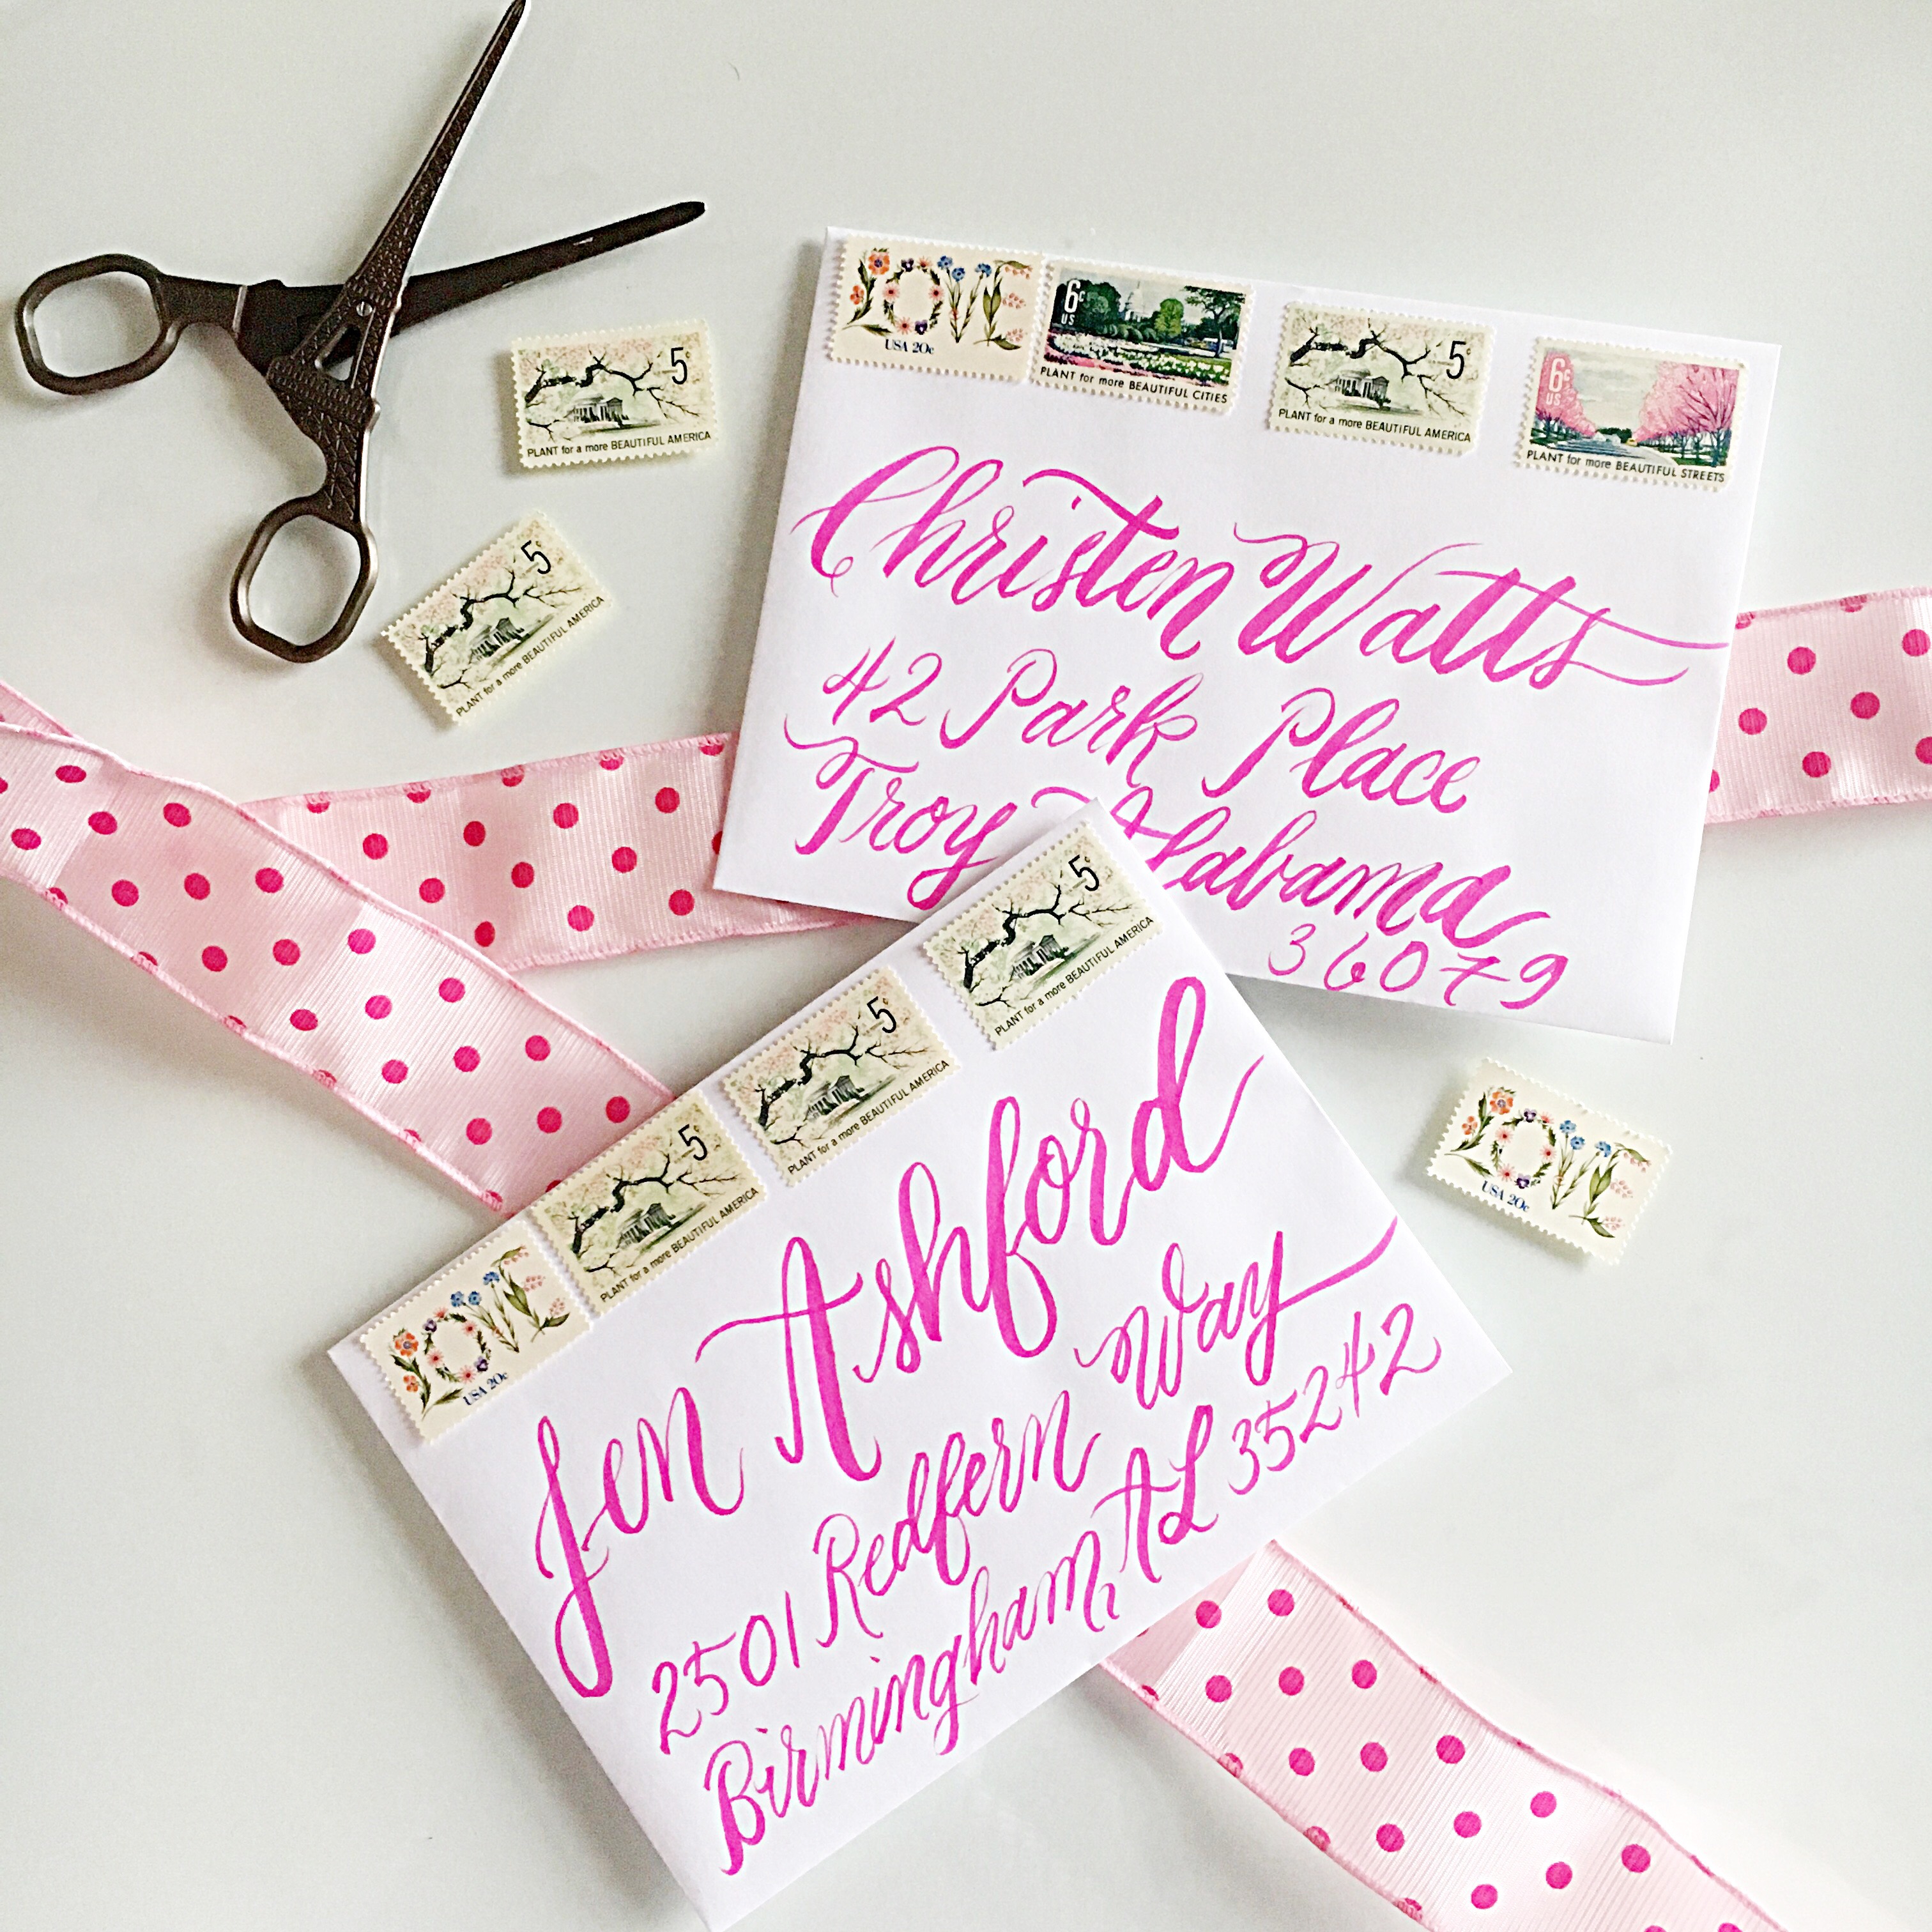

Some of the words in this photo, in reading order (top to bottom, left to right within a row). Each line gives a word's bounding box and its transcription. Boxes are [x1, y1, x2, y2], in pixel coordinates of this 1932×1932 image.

[885, 339, 908, 352] USA
[1061, 313, 1075, 325] US
[1040, 367, 1077, 381] PLANT
[1079, 372, 1094, 383] for
[1099, 377, 1124, 388] more
[1129, 380, 1188, 399] BEAUTIFUL
[1192, 390, 1228, 404] CITIES
[1278, 408, 1312, 422] PLANT
[1314, 413, 1327, 424] for
[1338, 417, 1363, 429] more
[1365, 420, 1422, 437] BEAUTIFUL
[1424, 427, 1471, 443] AMERICA
[1545, 392, 1561, 406] US
[527, 447, 557, 457] PLANT
[585, 443, 608, 452] more
[611, 436, 664, 450] BEAUTIFUL
[668, 431, 711, 444] AMERICA
[1526, 450, 1563, 463] PLANT
[1567, 454, 1581, 464] for
[1585, 458, 1611, 469] more
[1616, 461, 1676, 477] BEAUTIFUL
[1681, 468, 1725, 482] STREETS
[792, 446, 1235, 661] Christen
[1233, 525, 1729, 691] Watts
[456, 693, 484, 717] PLANT
[483, 683, 495, 695] for
[502, 662, 523, 680] more
[522, 626, 569, 664] BEAUTIFUL
[567, 595, 604, 628] AMERICA
[822, 639, 942, 726] 42
[940, 648, 1200, 790] Park
[1202, 687, 1481, 813] Place
[783, 717, 1018, 910] Troy
[994, 1010, 1025, 1036] PLANT
[1023, 1002, 1037, 1015] for
[1045, 981, 1066, 1000] more
[1065, 946, 1116, 985] BEAUTIFUL
[1114, 916, 1154, 949] AMERICA
[787, 1151, 817, 1175] PLANT
[817, 1142, 830, 1155] for
[838, 1122, 860, 1141] more
[859, 1089, 910, 1126] BEAUTIFUL
[908, 1059, 950, 1092] AMERICA
[600, 1278, 629, 1303] PLANT
[629, 1270, 642, 1282] for
[643, 1266, 650, 1275] a
[650, 1250, 671, 1269] more
[671, 1216, 720, 1254] BEAUTIFUL
[719, 1187, 759, 1220] AMERICA
[1482, 1180, 1504, 1200] USA
[535, 1386, 745, 1698] Jen
[694, 976, 1264, 1482] Ashford
[463, 1386, 487, 1406] USA
[1092, 1404, 1219, 1584] AL
[1229, 1303, 1443, 1496] 35242
[651, 1591, 801, 1756] 2501
[813, 1390, 1101, 1648] Redfern
[1073, 1217, 1398, 1411] Way
